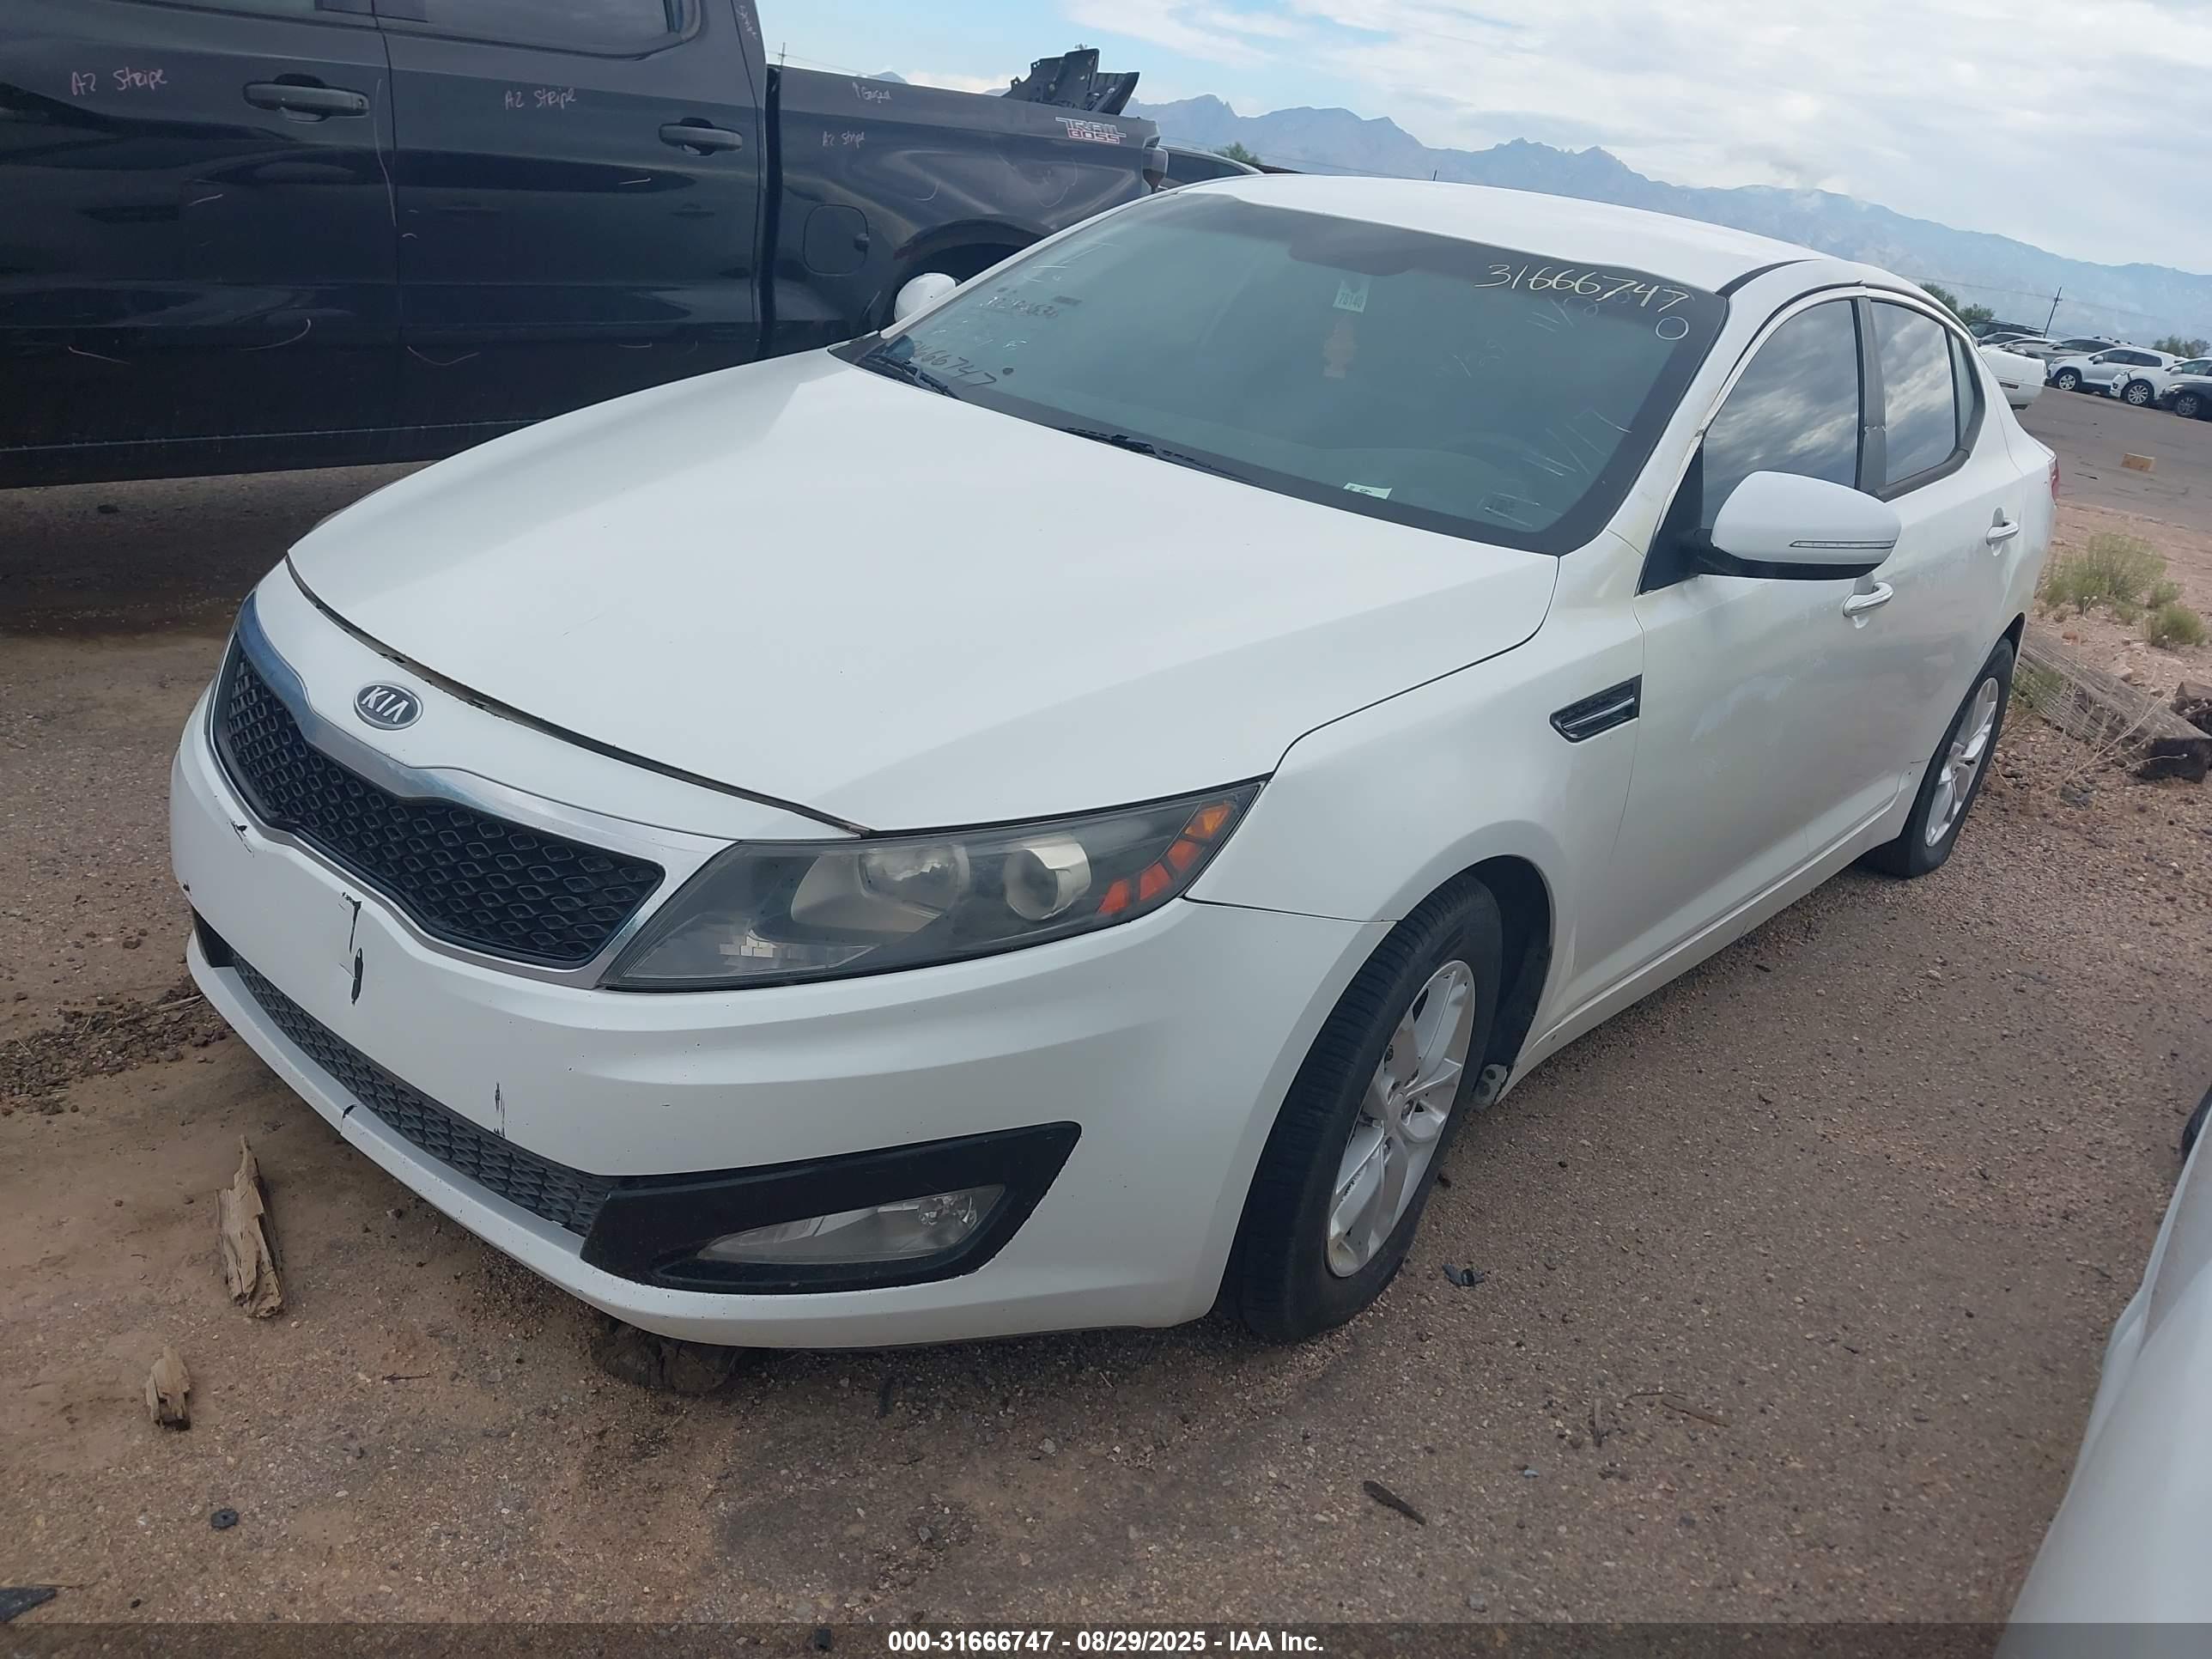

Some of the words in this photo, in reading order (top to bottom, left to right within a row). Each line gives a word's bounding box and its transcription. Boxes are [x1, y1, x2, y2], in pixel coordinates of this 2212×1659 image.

[1055, 116, 1127, 137] TRAIL
[1067, 130, 1120, 144] BOSS
[1474, 264, 1690, 313] 31666747
[361, 686, 410, 723] KIA
